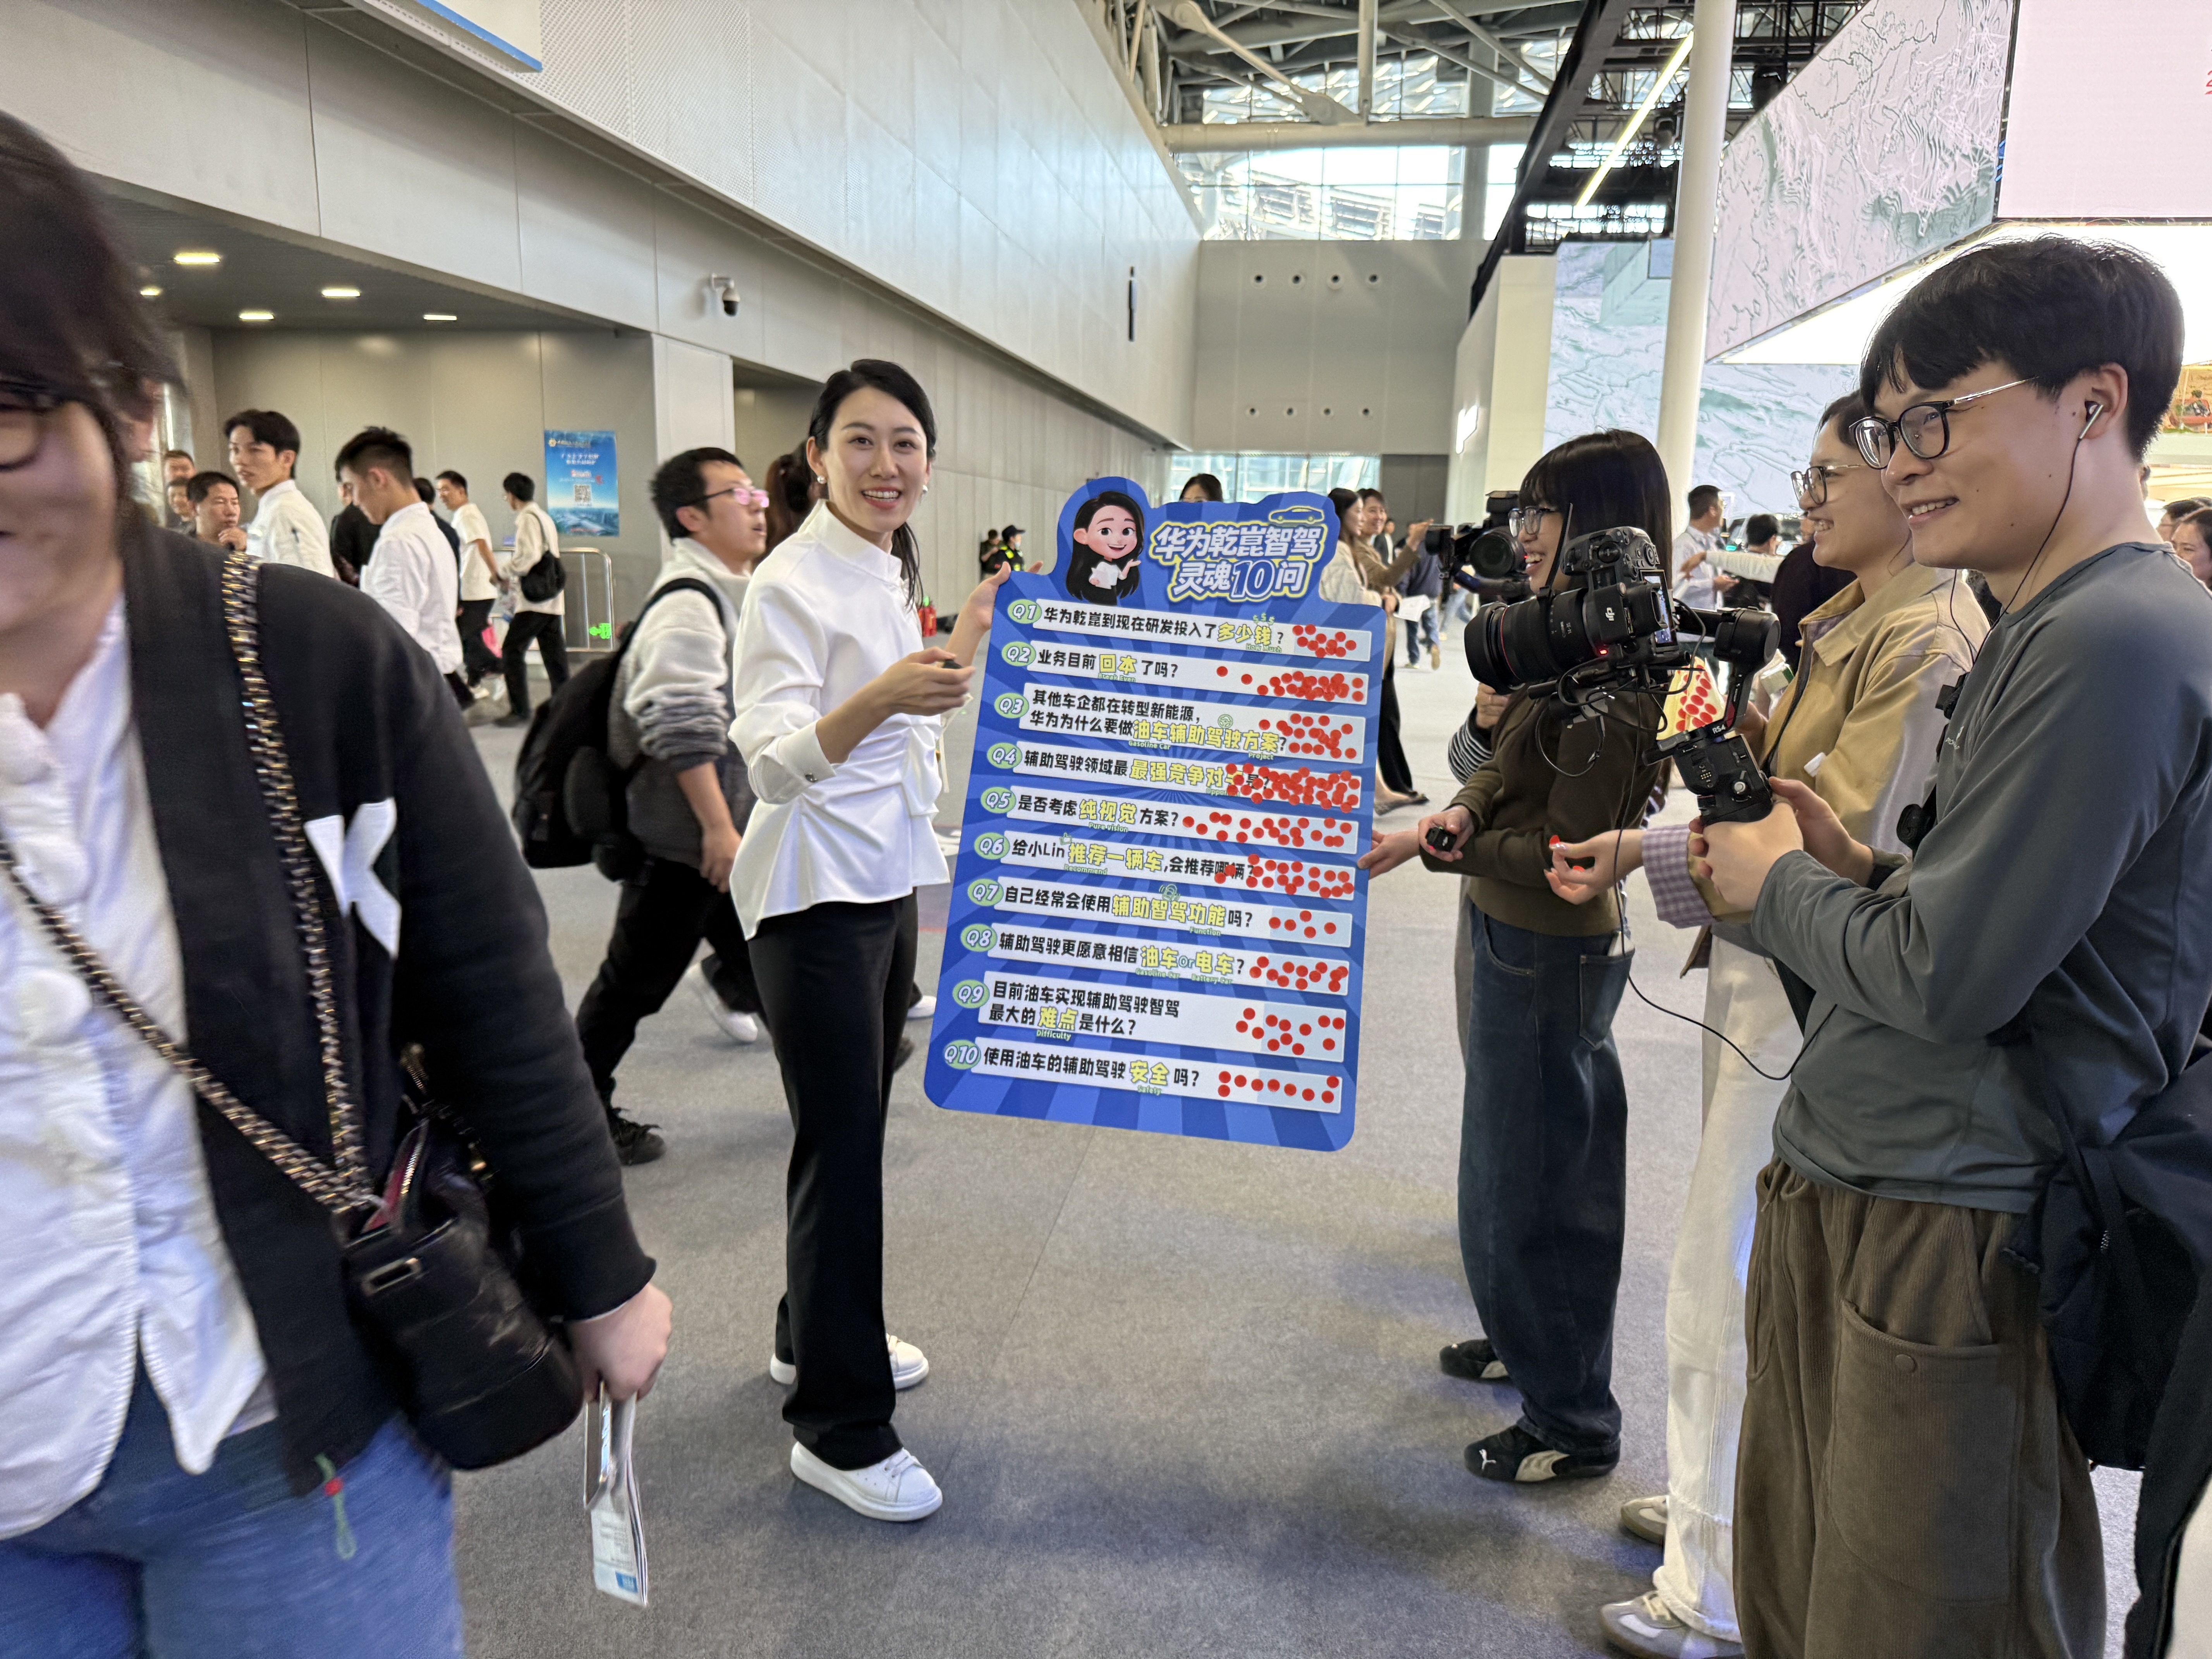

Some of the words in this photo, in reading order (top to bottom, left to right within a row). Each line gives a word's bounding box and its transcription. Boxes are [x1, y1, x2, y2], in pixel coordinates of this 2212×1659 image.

[1155, 524, 1322, 559] 华为乾崑智驾
[1173, 560, 1307, 598] 灵魂10问
[1012, 604, 1037, 620] Q1
[1007, 646, 1030, 663] Q2
[1000, 698, 1024, 714] Q3
[1128, 740, 1158, 749] Gasoline
[993, 747, 1017, 764] Q4
[1249, 752, 1274, 760] Project
[986, 792, 1012, 808] Q5
[1089, 821, 1106, 830] Pure
[1107, 824, 1128, 833] vision
[979, 838, 1004, 855] Q6
[1064, 863, 1108, 875] Recommend
[973, 884, 998, 901] Q7
[967, 930, 991, 947] Q8
[1190, 926, 1221, 936] Function
[1135, 968, 1166, 978] Gasoline
[1192, 973, 1218, 984] Battery
[958, 986, 984, 1002] Q9
[993, 980, 1180, 1018] 目前油车实现辅助驾驶智驾
[1036, 1029, 1071, 1041] Difficulty
[944, 1045, 979, 1064] Q10
[1137, 1085, 1162, 1097] Safety
